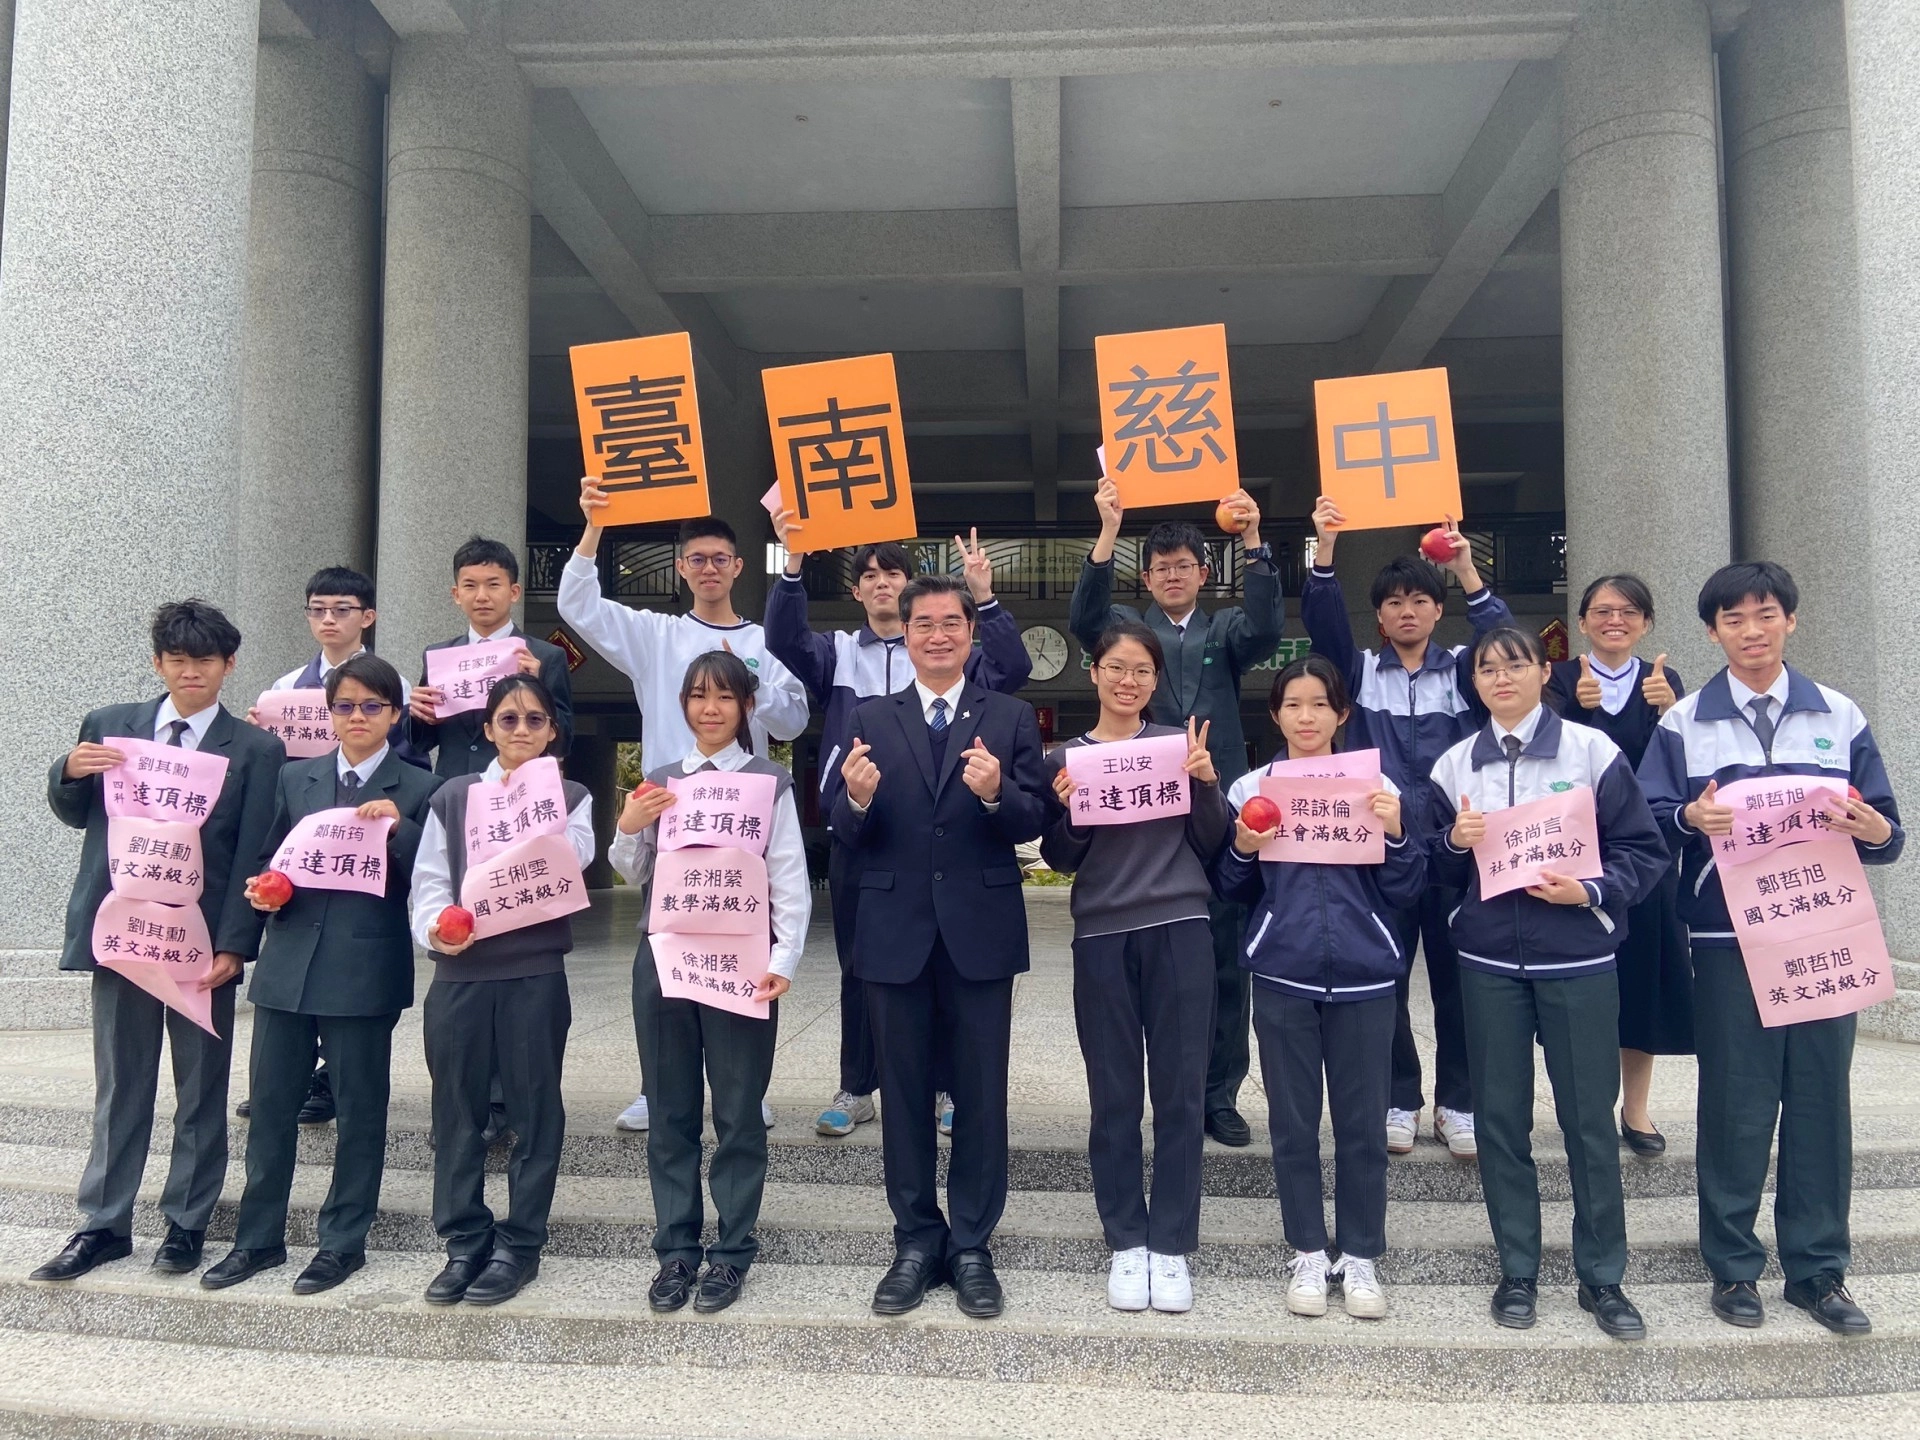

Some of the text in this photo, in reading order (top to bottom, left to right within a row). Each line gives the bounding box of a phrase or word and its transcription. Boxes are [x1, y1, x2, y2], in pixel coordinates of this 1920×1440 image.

[1108, 359, 1228, 473] 慈
[584, 374, 698, 493] 臺
[777, 397, 898, 520] 南
[1332, 402, 1441, 499] 中
[137, 756, 190, 778] 劉其勳
[1102, 755, 1153, 774] 王以安
[112, 780, 125, 804] 四科
[132, 781, 208, 817] 達頂標
[489, 782, 528, 811] 王俐雯
[1078, 787, 1092, 812] 四科
[1099, 780, 1182, 811] 達頂標
[1745, 787, 1806, 811] 鄭哲旭
[487, 798, 559, 843] 達頂標
[1290, 798, 1351, 818] 梁詠倫
[469, 826, 481, 851] 四科
[665, 814, 678, 839] 四科
[682, 809, 762, 840] 達頂標
[1503, 816, 1563, 850] 徐尚言
[127, 835, 192, 862] 劉其勳
[278, 846, 295, 871] 四科
[1488, 838, 1587, 877] 社會滿級分
[110, 858, 201, 887] 國文滿級分
[298, 849, 382, 881] 達頂標
[488, 857, 550, 890] 王俐雯
[1755, 863, 1827, 896] 鄭哲旭
[473, 877, 574, 918] 國文滿級分
[660, 893, 761, 914] 數學滿級分
[1743, 884, 1857, 926] 國文滿級分
[127, 916, 187, 943] 劉其勳
[102, 934, 205, 964] 英文滿級分
[1783, 947, 1854, 979] 鄭哲旭
[671, 966, 759, 999] 自然滿級分
[1768, 967, 1881, 1006] 英文滿級分
